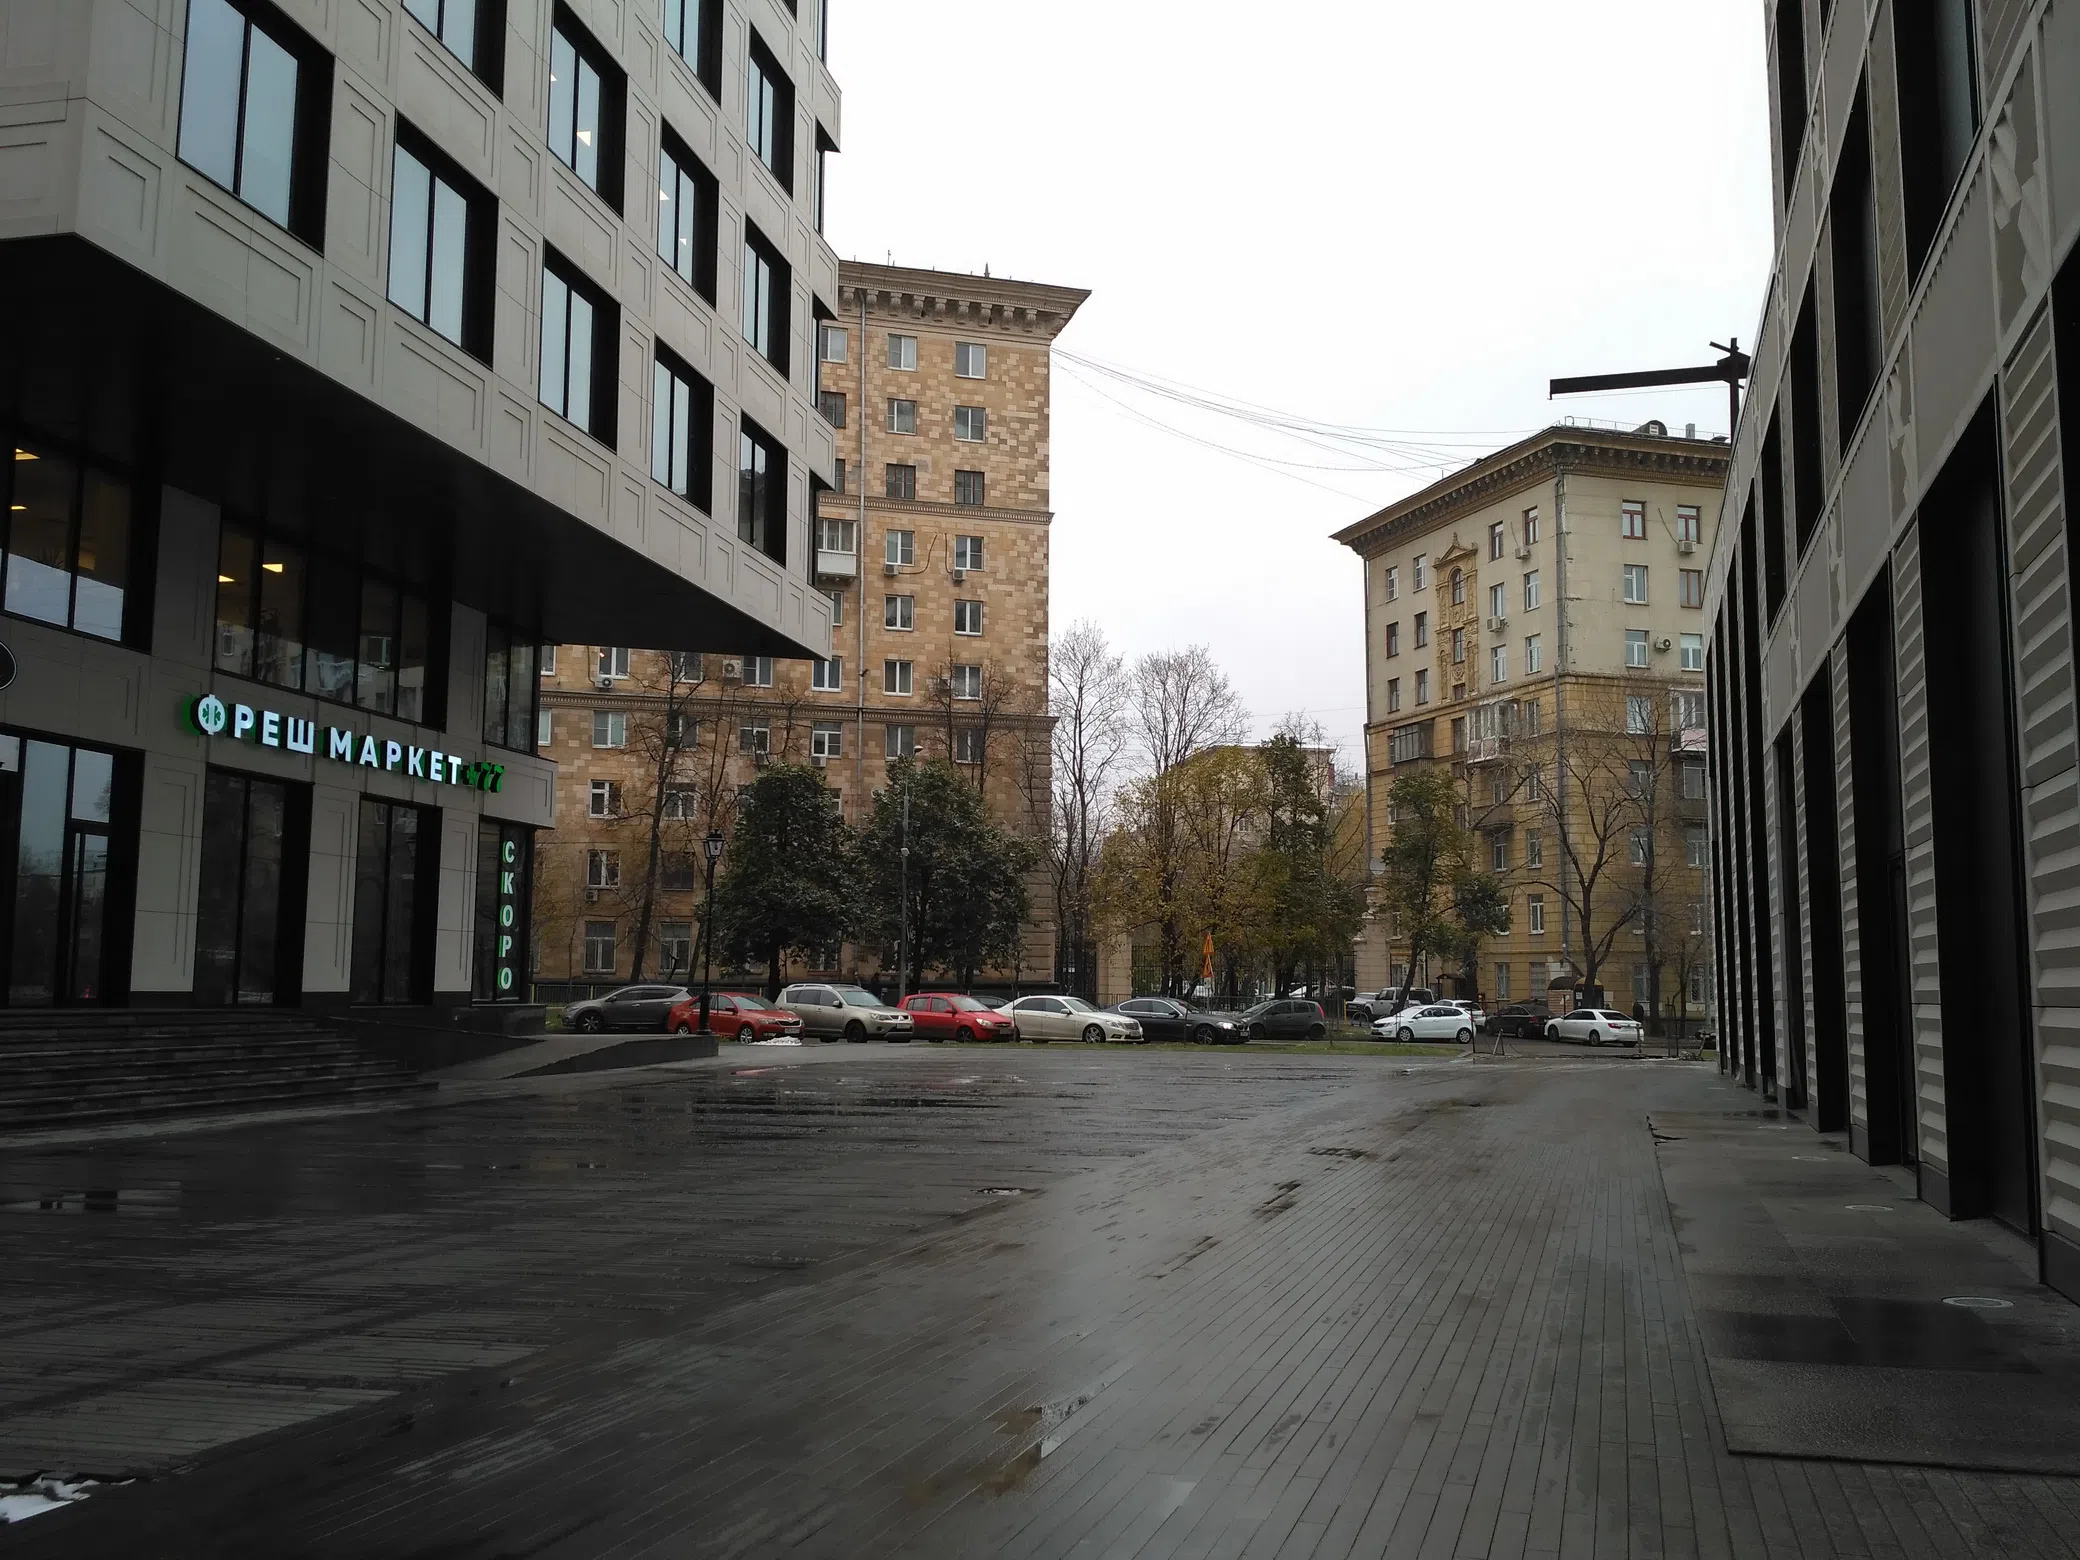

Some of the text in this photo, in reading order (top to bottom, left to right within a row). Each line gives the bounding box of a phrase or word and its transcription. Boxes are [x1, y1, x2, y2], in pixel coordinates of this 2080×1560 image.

[197, 694, 505, 793] ФРЕШ МАРКЕТ 77
[499, 840, 516, 990] СКОРО
